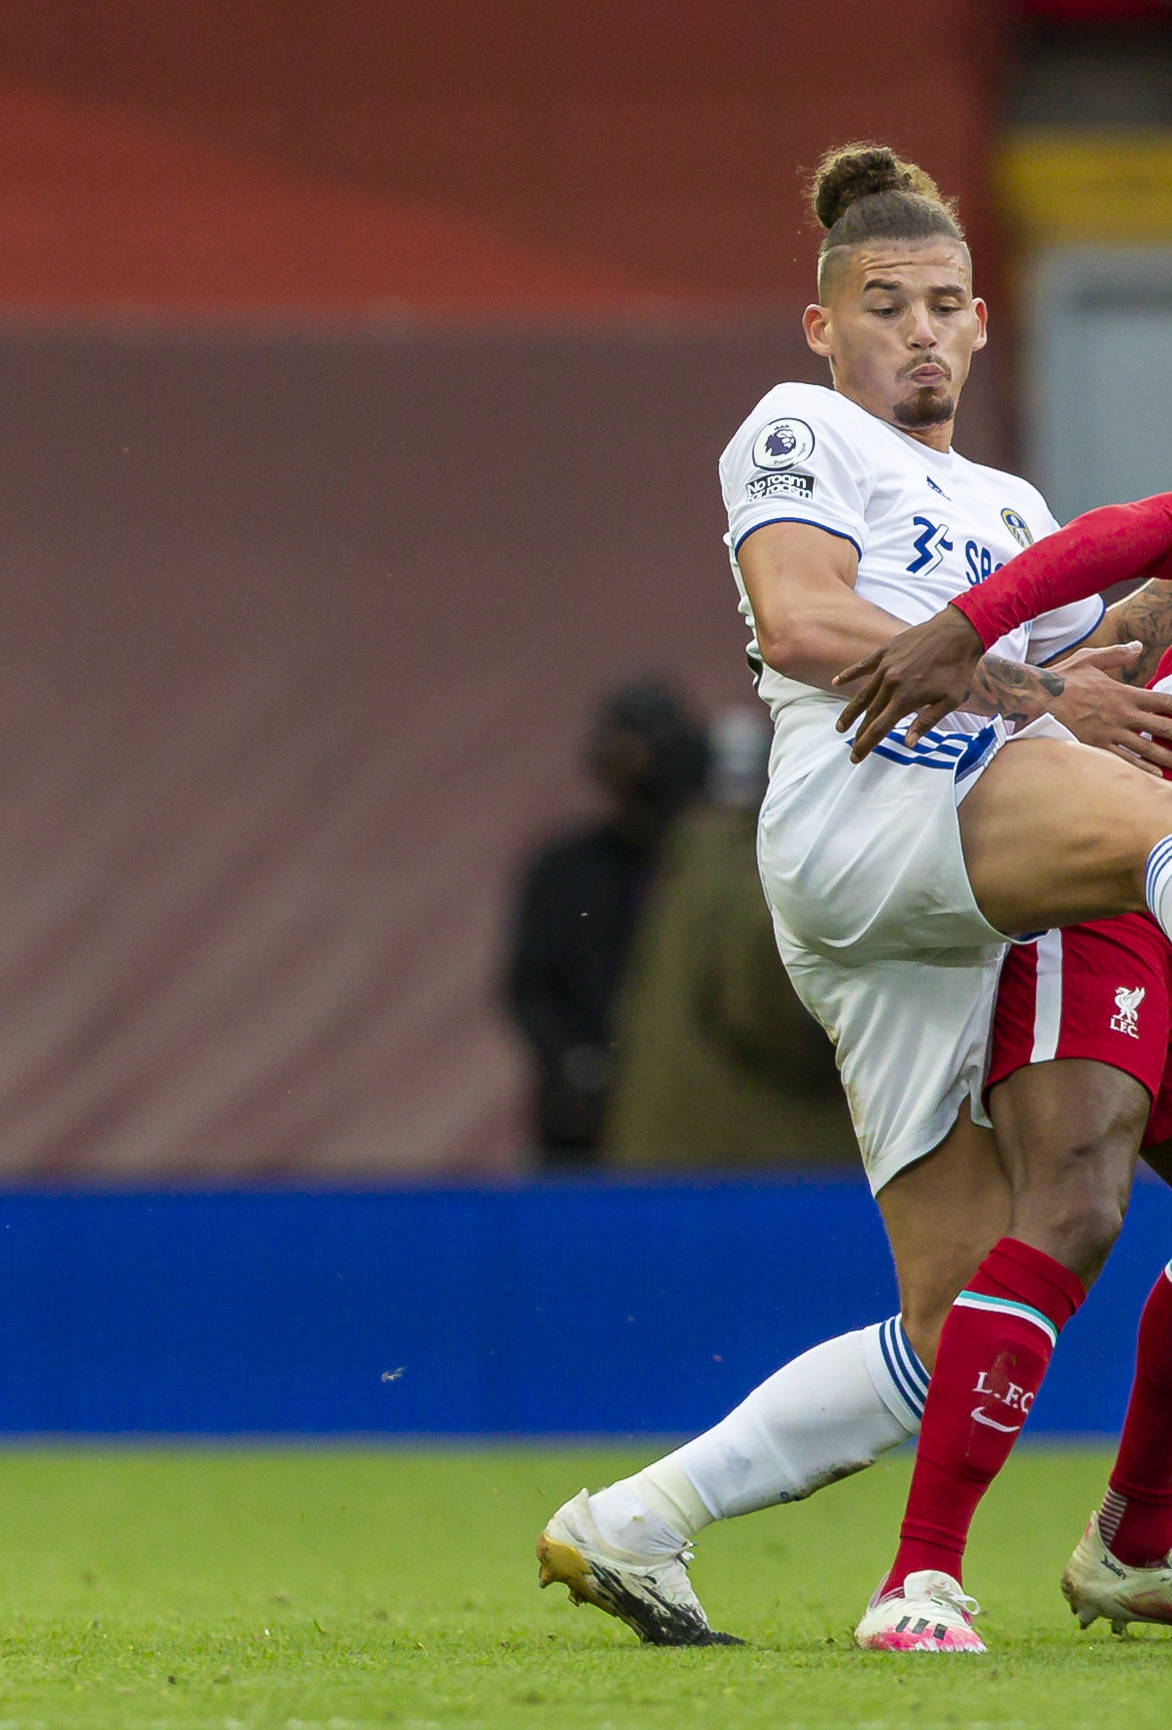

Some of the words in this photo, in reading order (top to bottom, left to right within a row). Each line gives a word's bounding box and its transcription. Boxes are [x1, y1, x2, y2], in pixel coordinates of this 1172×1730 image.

[747, 480, 767, 494] No
[766, 474, 807, 489] room
[1109, 1017, 1140, 1039] LFC
